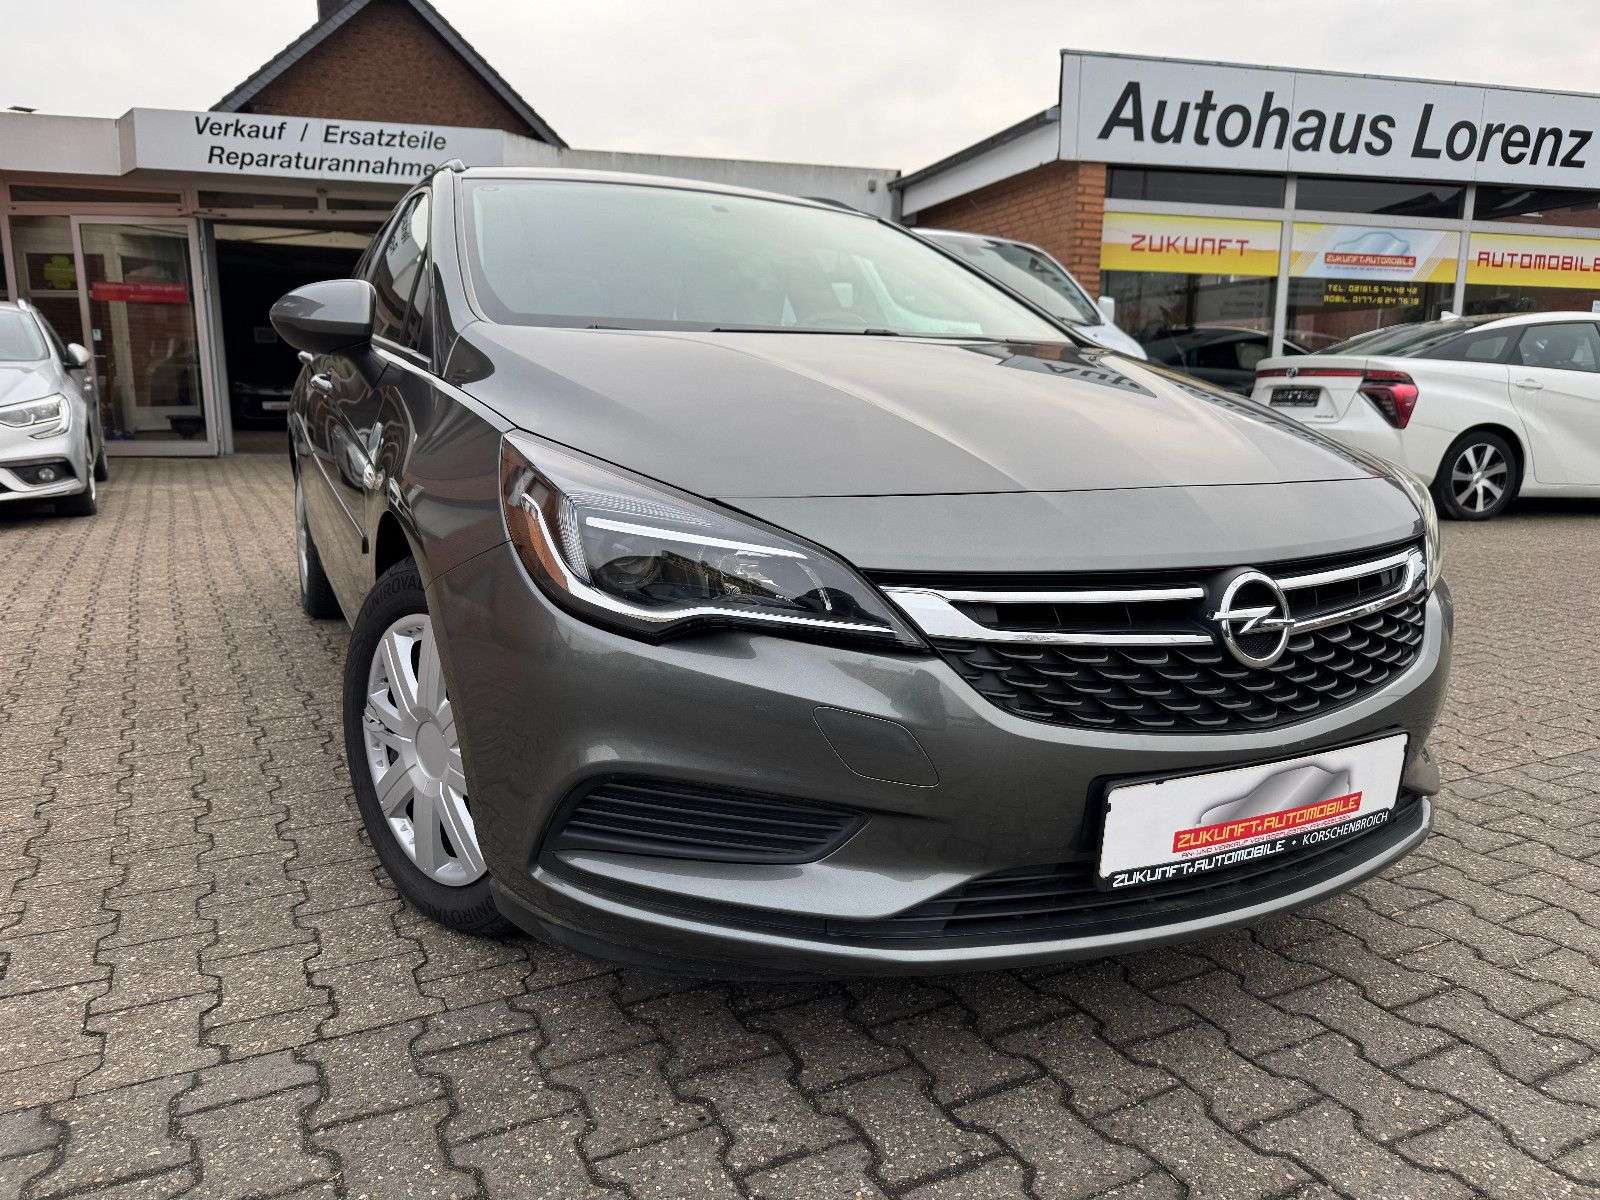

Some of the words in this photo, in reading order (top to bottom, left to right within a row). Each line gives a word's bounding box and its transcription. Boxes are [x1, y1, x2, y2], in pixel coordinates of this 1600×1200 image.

[195, 116, 287, 140] Verkauf
[323, 125, 447, 150] Ersatzteile
[1098, 81, 1396, 157] Autohaus
[1411, 103, 1593, 169] Lorenz
[208, 146, 436, 177] Reparaturannahme
[1130, 234, 1249, 256] ZUKUNFT
[1302, 810, 1389, 845] KORSCHENBROICH
